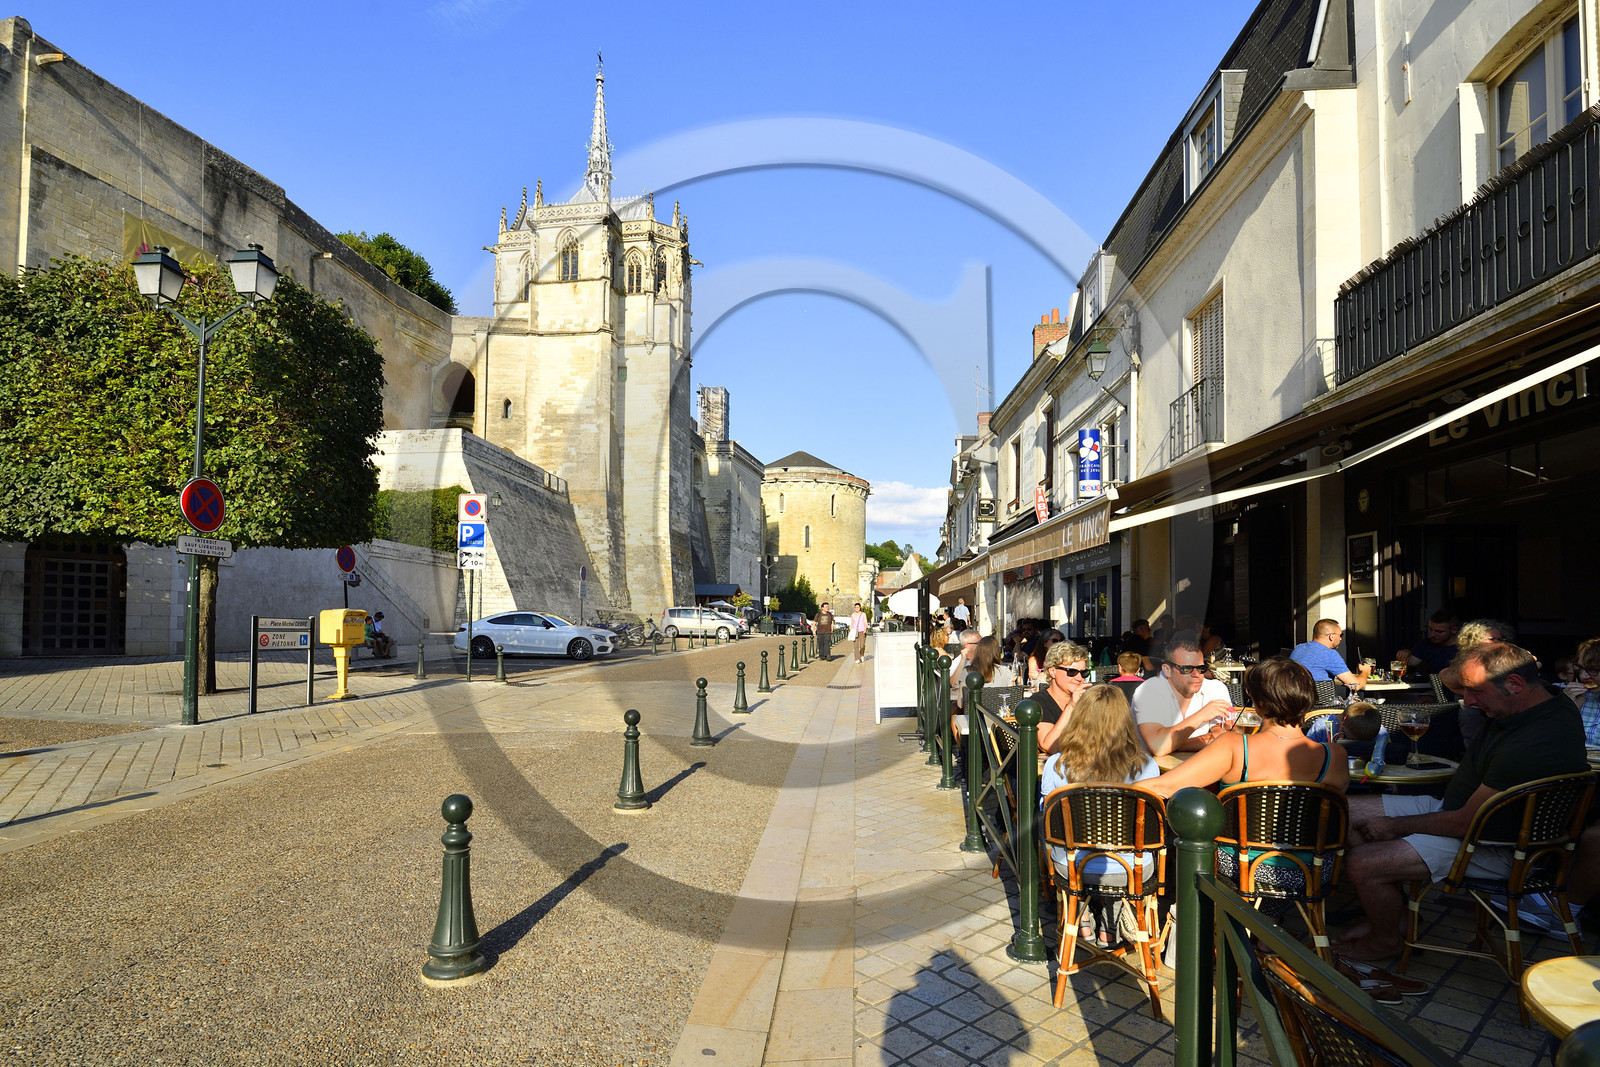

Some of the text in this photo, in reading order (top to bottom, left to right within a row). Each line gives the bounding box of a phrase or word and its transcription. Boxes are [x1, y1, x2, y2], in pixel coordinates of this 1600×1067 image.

[462, 525, 474, 542] P
[1062, 509, 1107, 547] LE VINCI
[198, 544, 226, 552] LIVRAISONS
